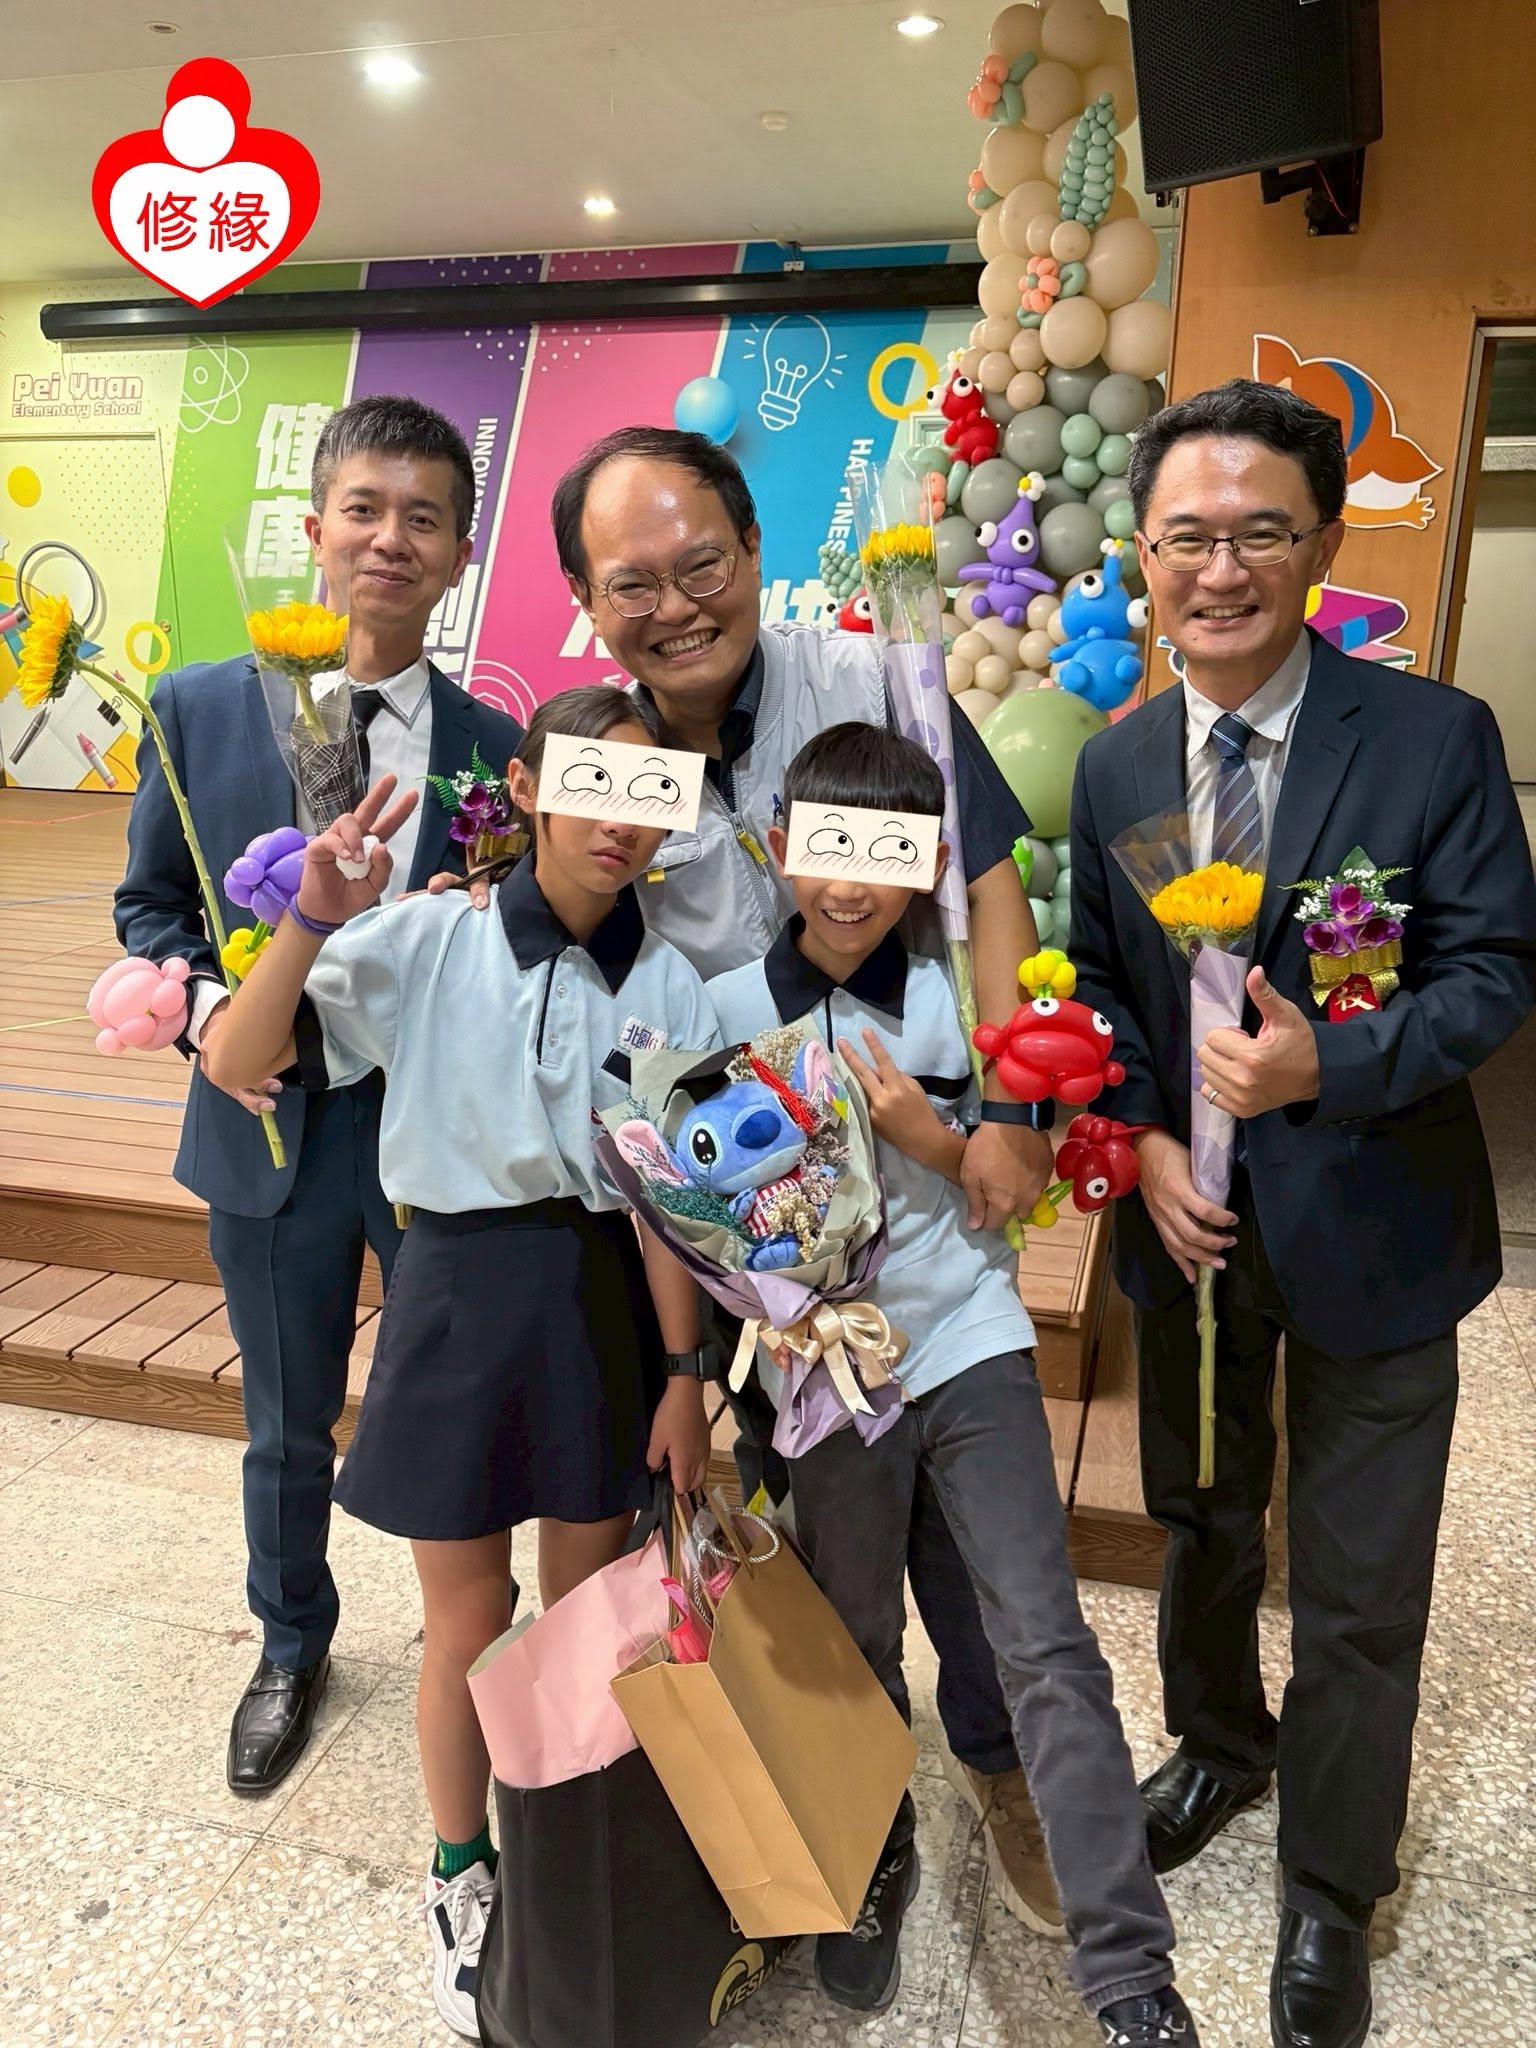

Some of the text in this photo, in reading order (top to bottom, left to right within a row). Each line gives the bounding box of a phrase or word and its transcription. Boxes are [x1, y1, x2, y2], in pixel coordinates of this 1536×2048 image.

[12, 372, 143, 402] Pei Yuan
[12, 400, 143, 419] Elementary School
[244, 402, 334, 578] 健康
